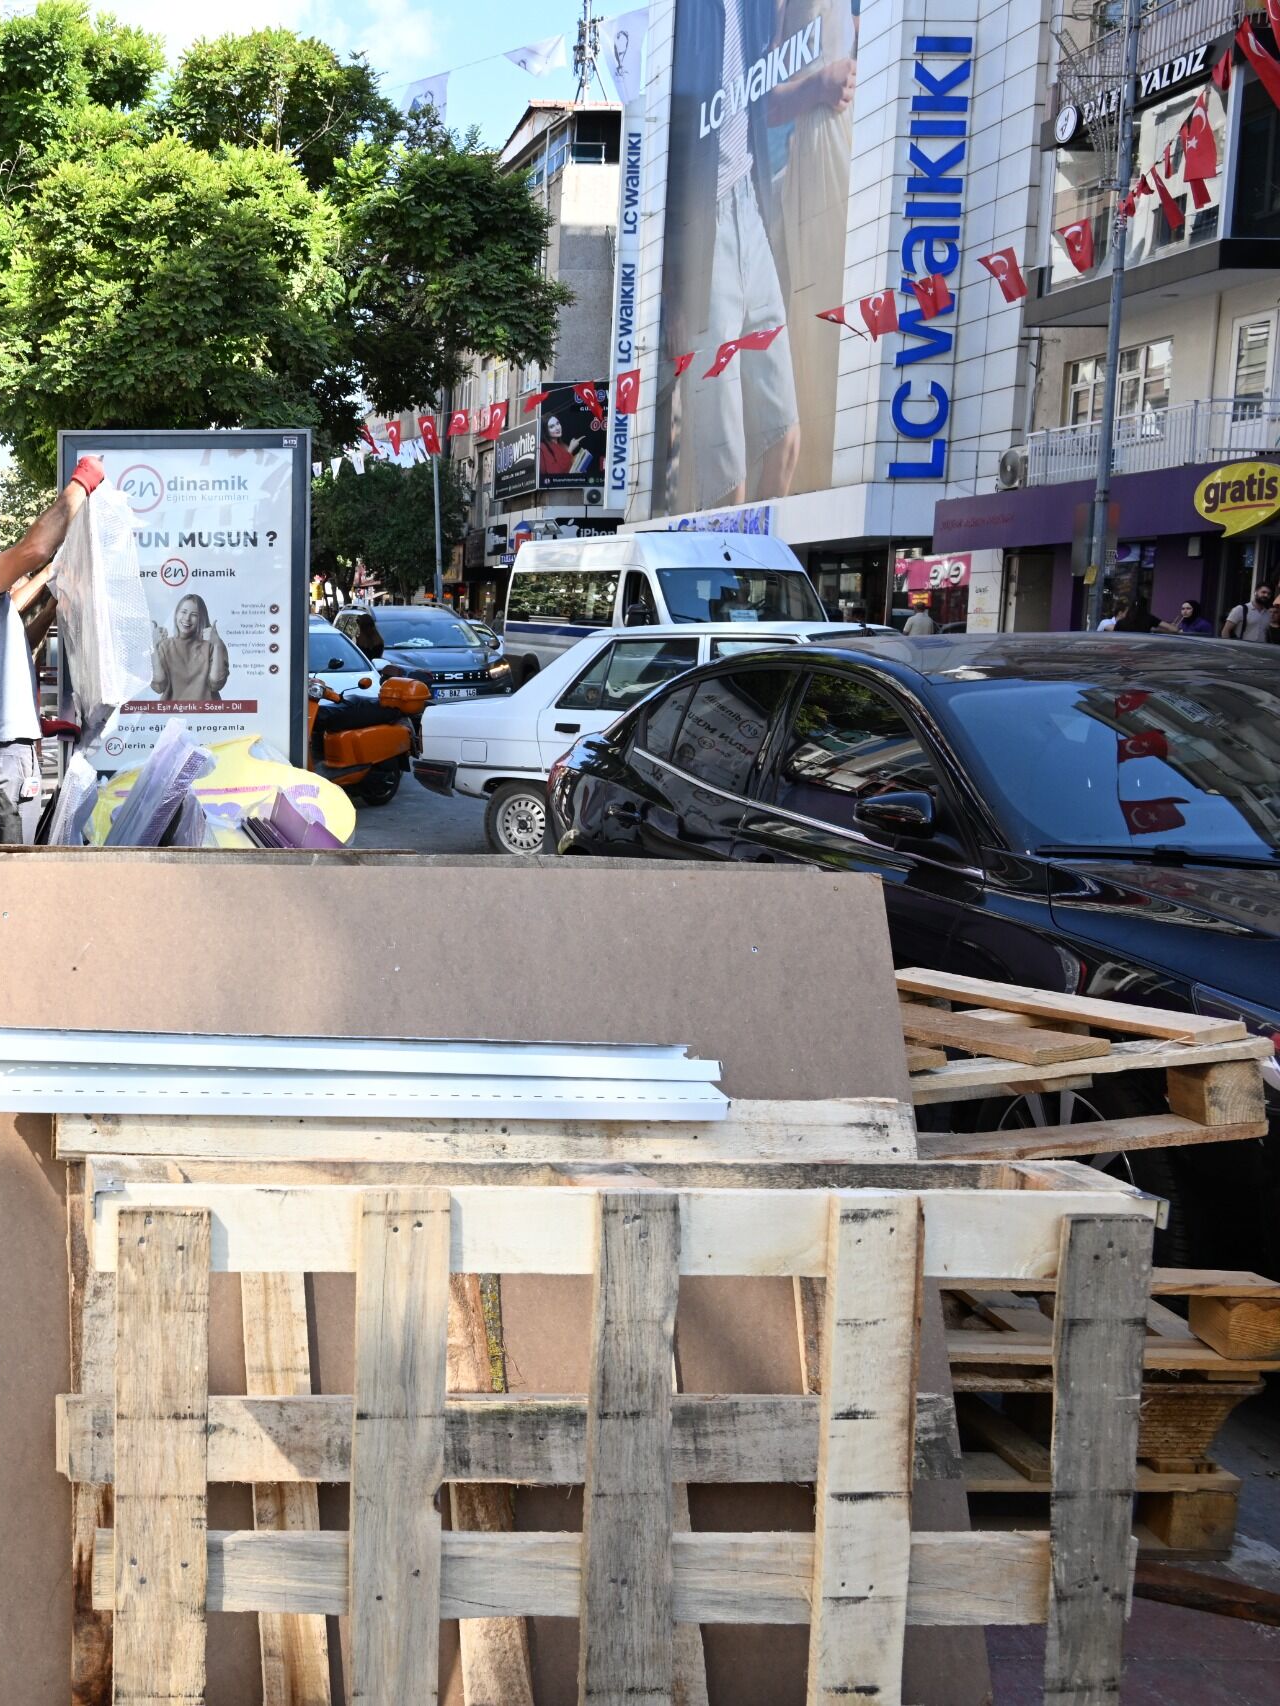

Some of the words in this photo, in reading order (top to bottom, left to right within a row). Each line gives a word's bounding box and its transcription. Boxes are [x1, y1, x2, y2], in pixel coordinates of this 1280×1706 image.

[1140, 45, 1208, 98] YALDIZ
[699, 88, 726, 139] LC
[623, 211, 637, 235] LC
[617, 341, 631, 364] LC
[886, 380, 949, 480] LC
[497, 432, 536, 474] bluewhite
[167, 475, 249, 492] dinamik
[611, 467, 626, 491] LC
[166, 494, 197, 504] Eğitim
[1203, 468, 1279, 514] gratis
[133, 531, 170, 548] UN
[178, 531, 259, 548] MUSUN
[265, 531, 278, 548] ?
[580, 527, 617, 538] iPhon
[164, 566, 186, 578] en
[191, 568, 236, 577] dinamik
[124, 703, 150, 712] Sayısal
[157, 704, 170, 713] Eşit
[173, 703, 197, 713] Ağırlık
[204, 702, 224, 711] Sözel
[231, 702, 242, 710] Dil
[118, 723, 146, 733] Doğru
[149, 724, 166, 733] eği
[196, 724, 245, 733] programla
